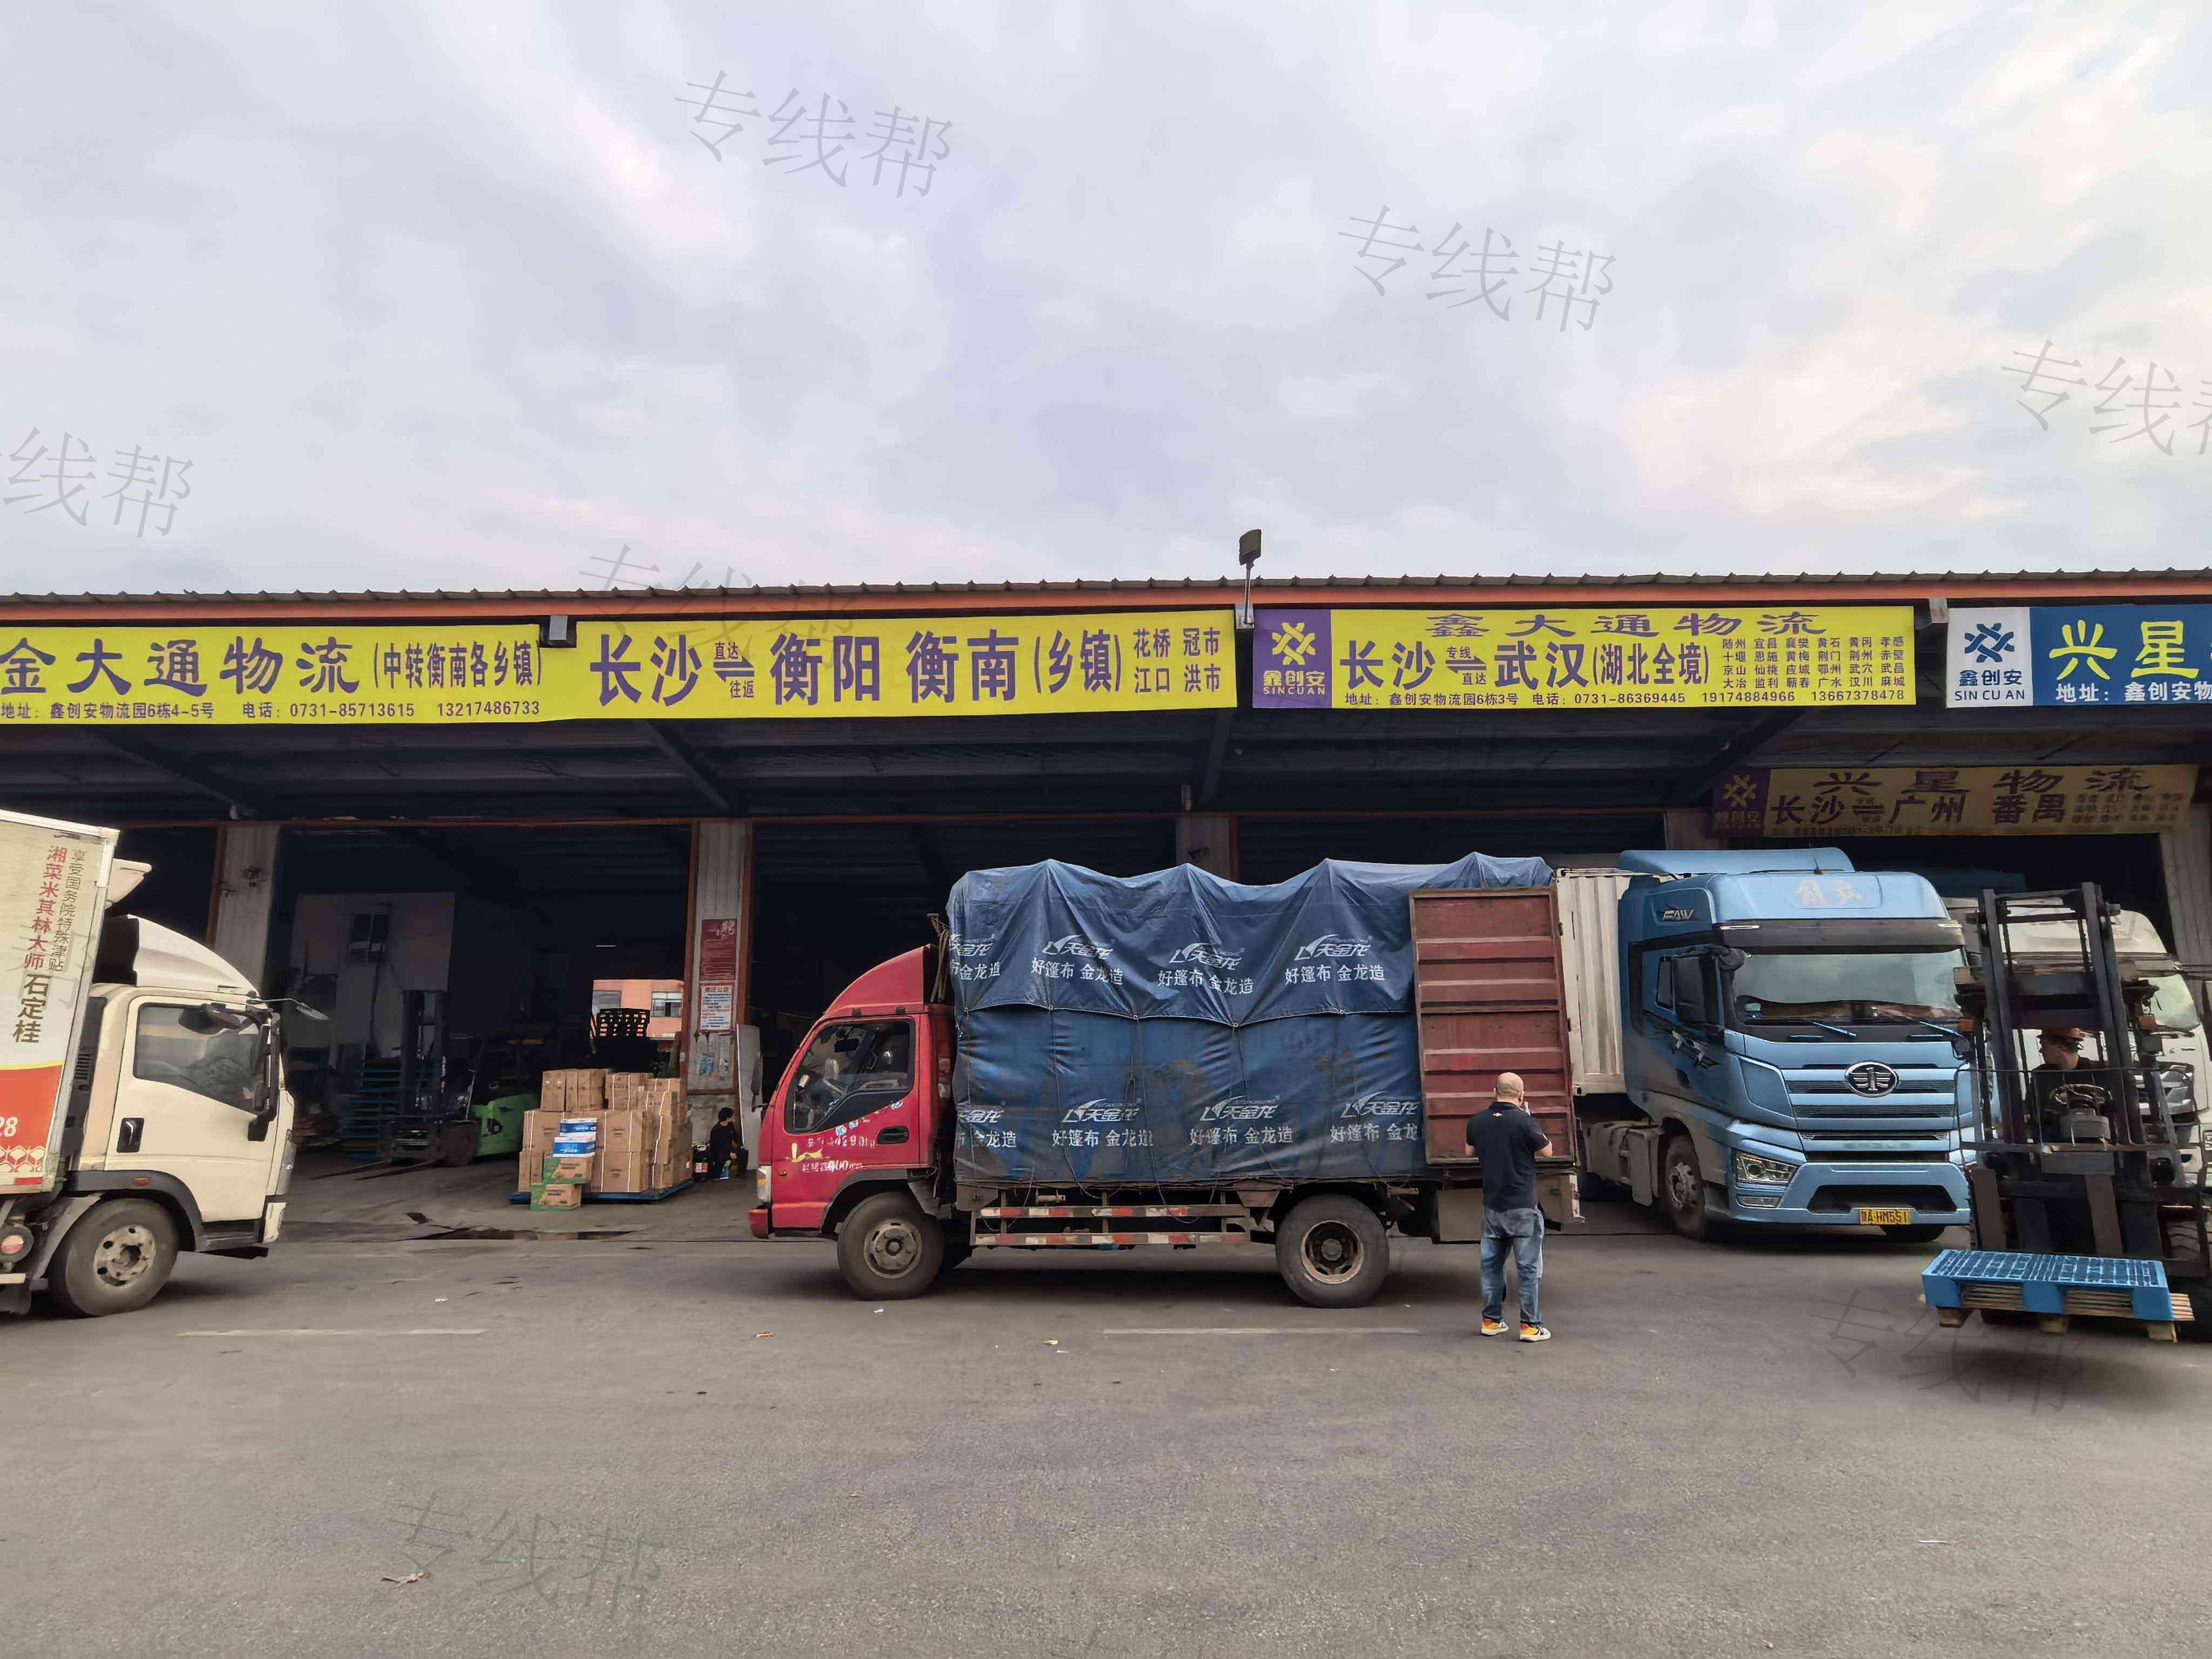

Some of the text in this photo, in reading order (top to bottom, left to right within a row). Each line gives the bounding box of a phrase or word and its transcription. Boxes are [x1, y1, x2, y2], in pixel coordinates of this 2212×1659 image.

[1425, 611, 1826, 637] 鑫大通物流
[714, 642, 739, 660] 直达
[1133, 628, 1171, 658] 花桥
[2049, 619, 2212, 679] 兴星
[1446, 646, 1472, 659] 专线
[0, 636, 360, 696] 金大通物流
[590, 634, 703, 706] 长沙
[770, 633, 880, 706] 衡阳
[1340, 640, 1435, 690] 长沙
[1723, 665, 1746, 675] 京山
[1755, 664, 1778, 675] 仙桃
[1850, 663, 1872, 674] 武穴
[1134, 663, 1221, 694] 江口 洪市
[1263, 671, 1325, 687] 鑫创安
[1462, 672, 1487, 685] 直达
[1723, 678, 1746, 689] 大冶
[1755, 677, 1778, 688] 监利
[1818, 677, 1841, 687] 广水
[1850, 676, 1872, 686] 汉川
[1959, 670, 2022, 686] 鑫创安
[729, 680, 754, 700] 往返
[1263, 687, 1325, 696] SINCUAN
[1702, 691, 1795, 703] 19174884966
[1811, 690, 1904, 701] 13667378478
[437, 700, 539, 717] 13217486733
[1771, 795, 1845, 825] 长沙
[1889, 794, 1966, 825] 广州
[1337, 964, 1385, 981] 金龙造
[12, 974, 53, 1043] 石定桂
